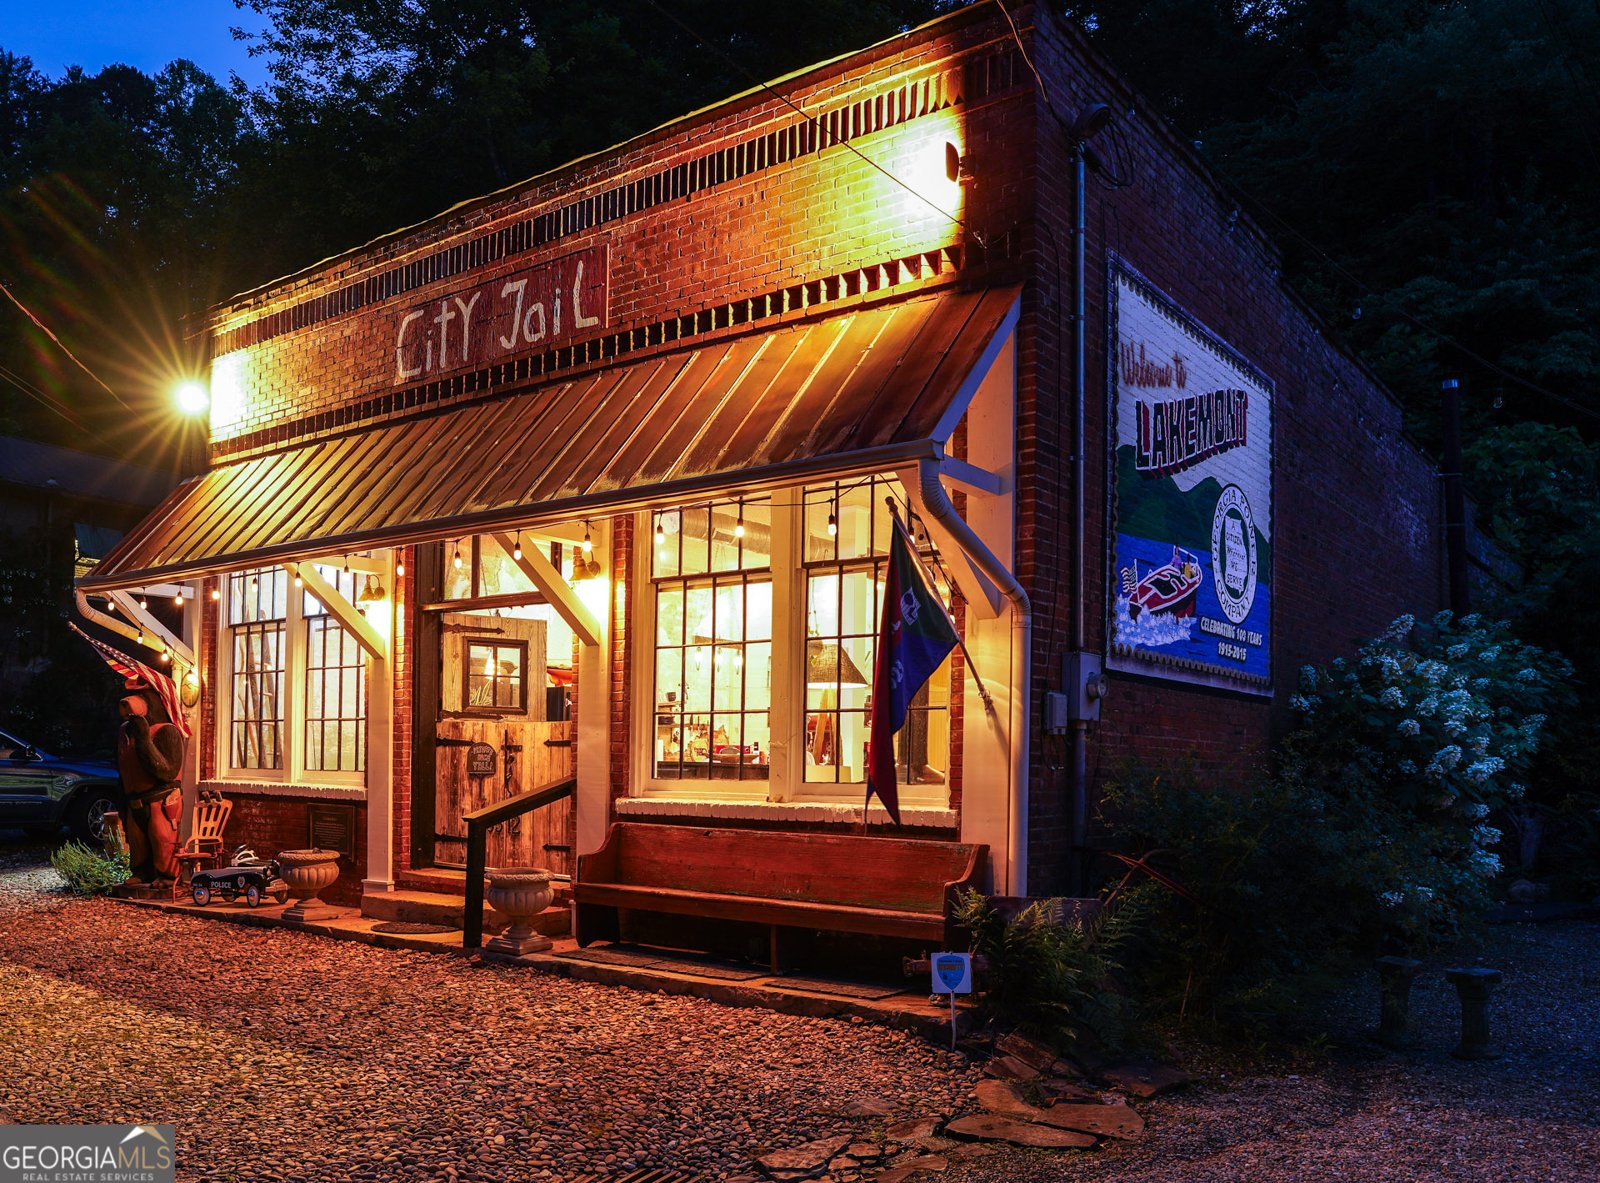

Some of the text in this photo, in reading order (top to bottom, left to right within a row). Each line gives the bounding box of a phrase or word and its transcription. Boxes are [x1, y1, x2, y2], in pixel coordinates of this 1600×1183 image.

[1119, 338, 1187, 389] Welcome to
[1135, 388, 1248, 474] LAKEMONT
[1200, 616, 1263, 646] CELEBRATING 100 YEARS
[1218, 641, 1247, 661] 1915-2015
[210, 881, 232, 889] POLICE
